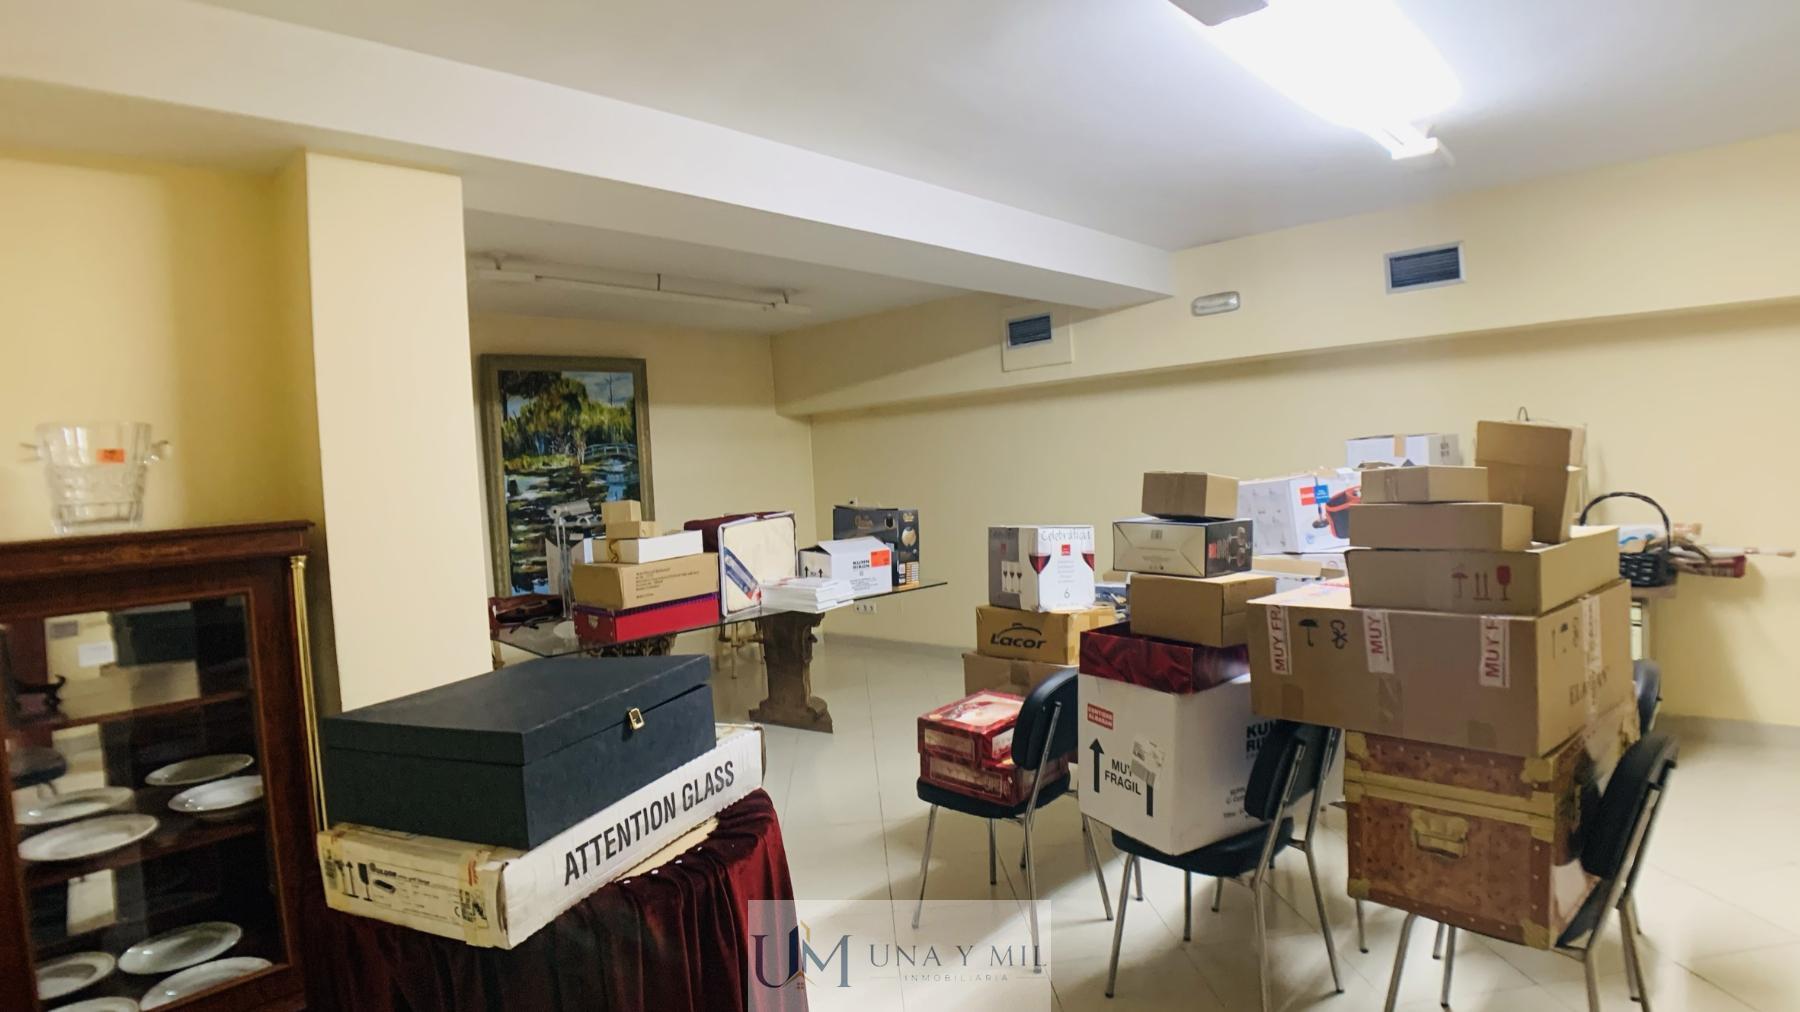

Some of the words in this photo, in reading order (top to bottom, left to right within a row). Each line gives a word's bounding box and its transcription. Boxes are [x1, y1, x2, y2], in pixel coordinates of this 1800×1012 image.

[1064, 586, 1070, 599] 6
[991, 633, 1047, 649] Lacor
[1368, 615, 1384, 655] MUY
[1270, 637, 1286, 672] MUY
[1485, 636, 1500, 678] MUY
[1104, 769, 1142, 796] FRAGIL
[565, 792, 677, 886] ATTENTION
[682, 760, 735, 812] GLASS
